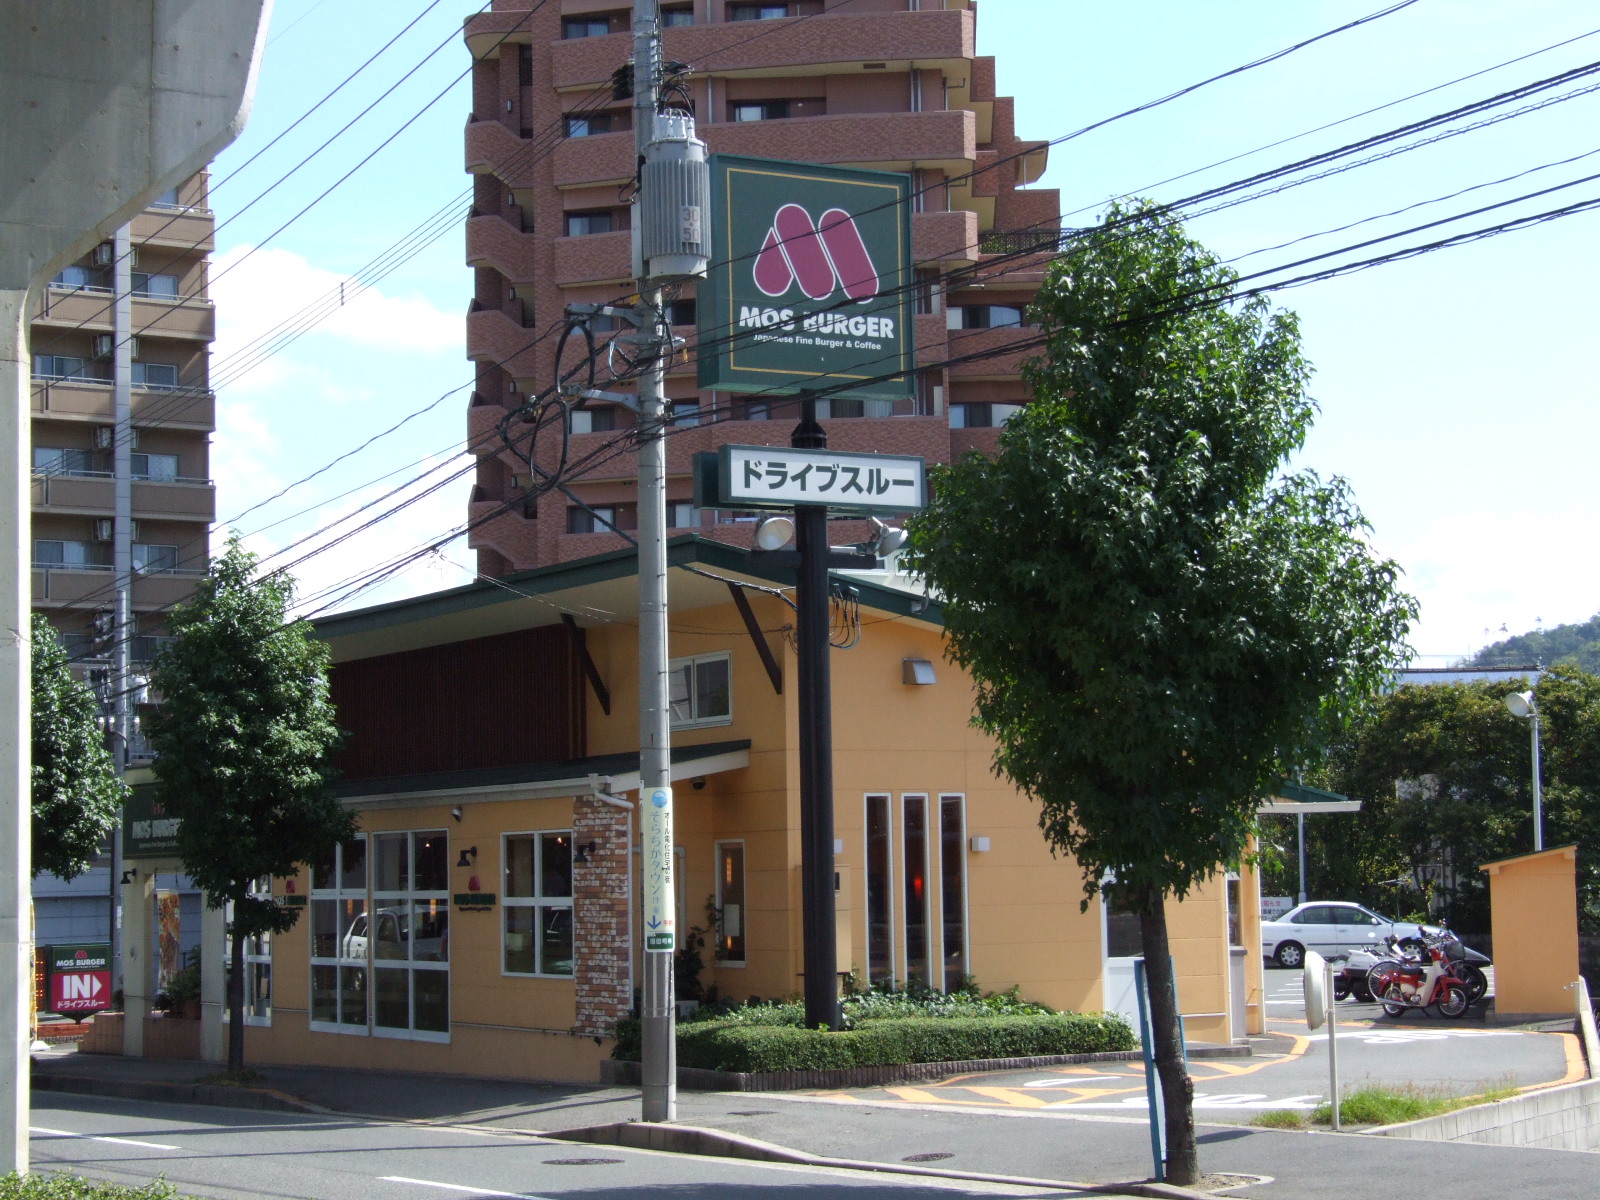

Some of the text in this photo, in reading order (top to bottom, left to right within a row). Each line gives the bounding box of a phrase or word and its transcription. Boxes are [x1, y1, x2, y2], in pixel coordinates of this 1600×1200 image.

[683, 207, 699, 222] 30
[683, 227, 699, 241] 50
[738, 305, 895, 339] MOS BURGER
[795, 335, 813, 345] Fine
[815, 337, 844, 349] Burger
[854, 340, 882, 350] Coffee
[743, 459, 915, 496] ドライブスルー
[132, 819, 151, 839] MOS
[56, 958, 106, 967] MOS BURGER
[63, 974, 91, 999] IN
[57, 999, 105, 1009] ドライブスルー
